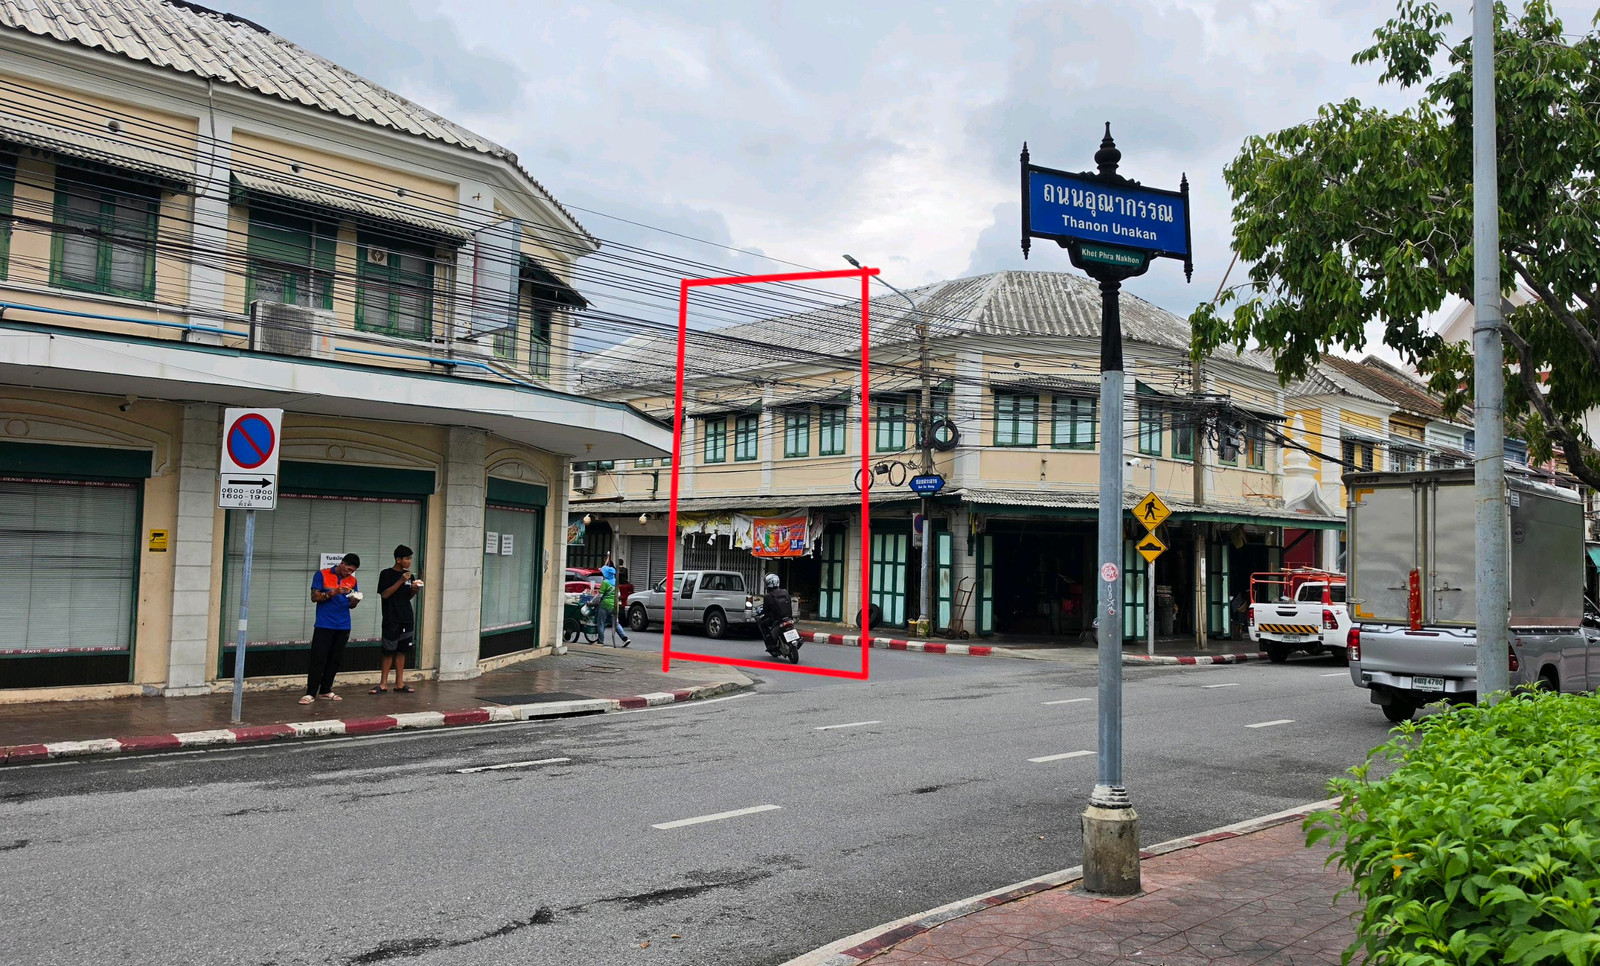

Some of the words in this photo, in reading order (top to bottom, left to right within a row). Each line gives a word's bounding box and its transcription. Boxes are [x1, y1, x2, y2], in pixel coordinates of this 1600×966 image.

[1043, 183, 1174, 223] ถนนอุณากรรณ
[1062, 215, 1109, 233] Thanon
[1112, 222, 1157, 241] Unakan
[1081, 248, 1098, 258] Khet
[1099, 251, 1114, 261] Phra
[1115, 253, 1140, 264] Nakhon
